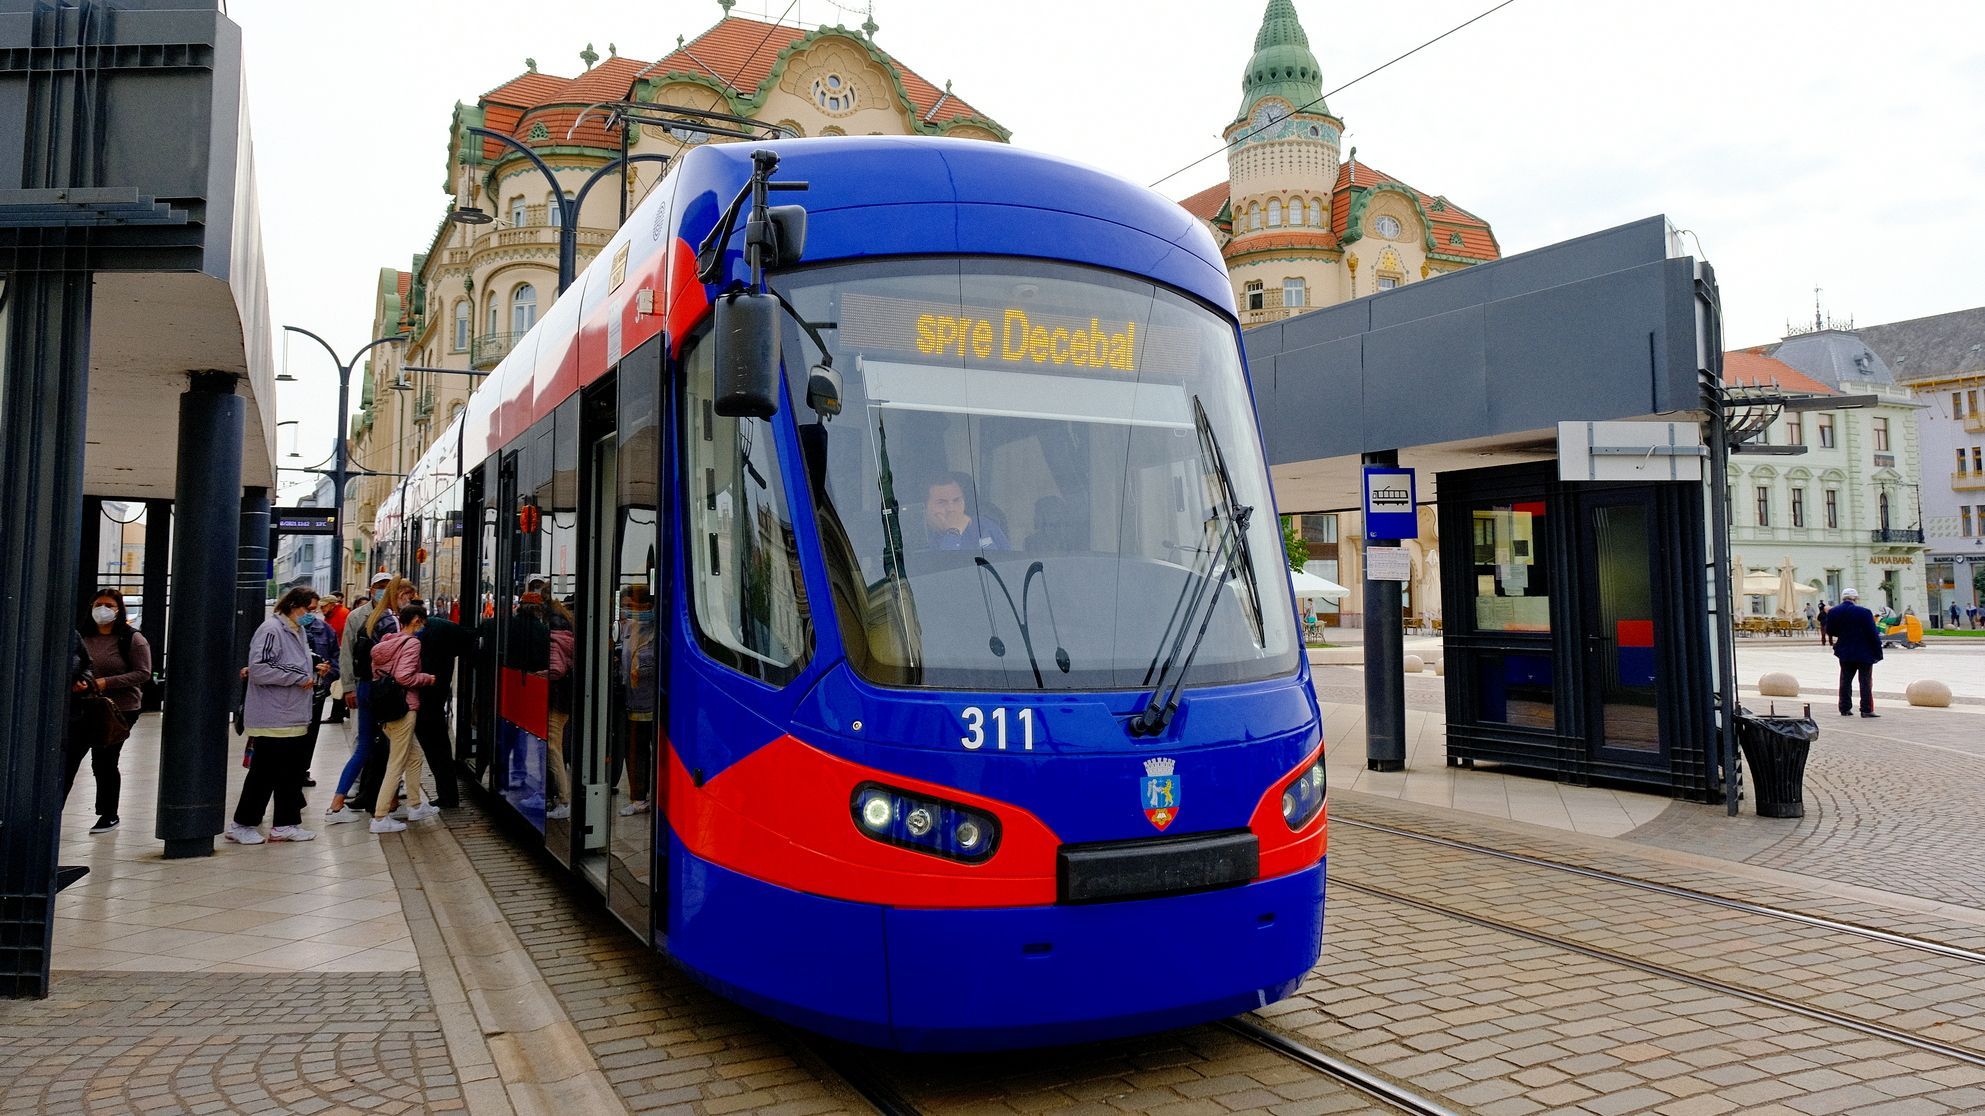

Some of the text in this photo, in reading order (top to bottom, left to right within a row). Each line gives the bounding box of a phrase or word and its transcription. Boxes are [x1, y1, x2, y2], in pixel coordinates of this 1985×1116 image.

[916, 309, 1135, 371] spre Decebal
[1869, 556, 1914, 565] ALPHA BANK
[961, 706, 1033, 750] 311
